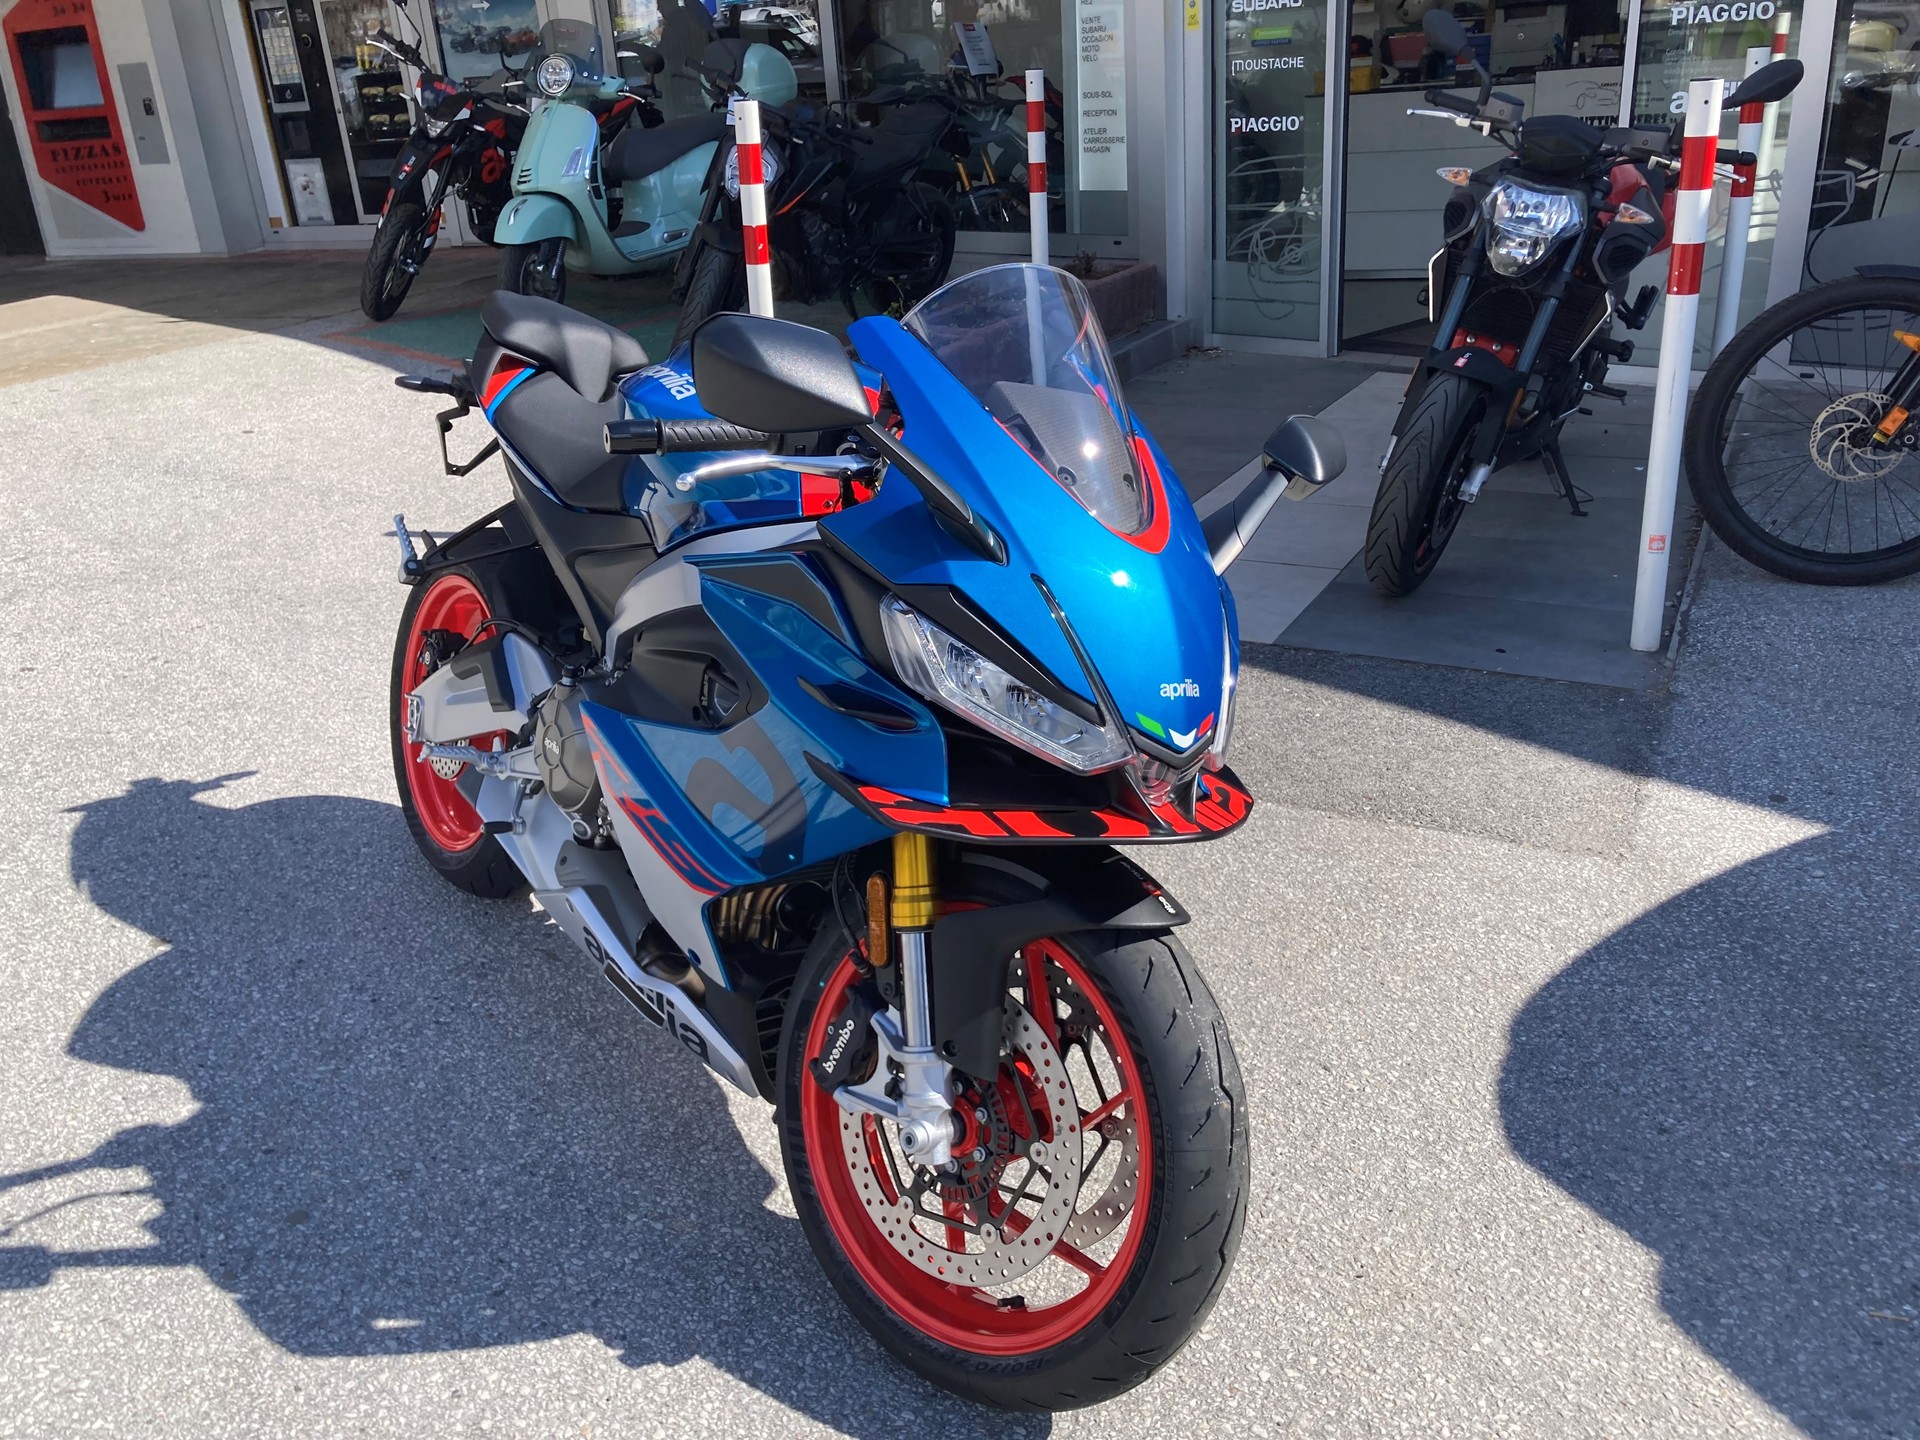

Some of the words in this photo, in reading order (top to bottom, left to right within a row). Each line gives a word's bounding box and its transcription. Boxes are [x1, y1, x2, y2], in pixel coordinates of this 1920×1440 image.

[1671, 2, 1775, 25] PIAGGIO
[1081, 16, 1101, 24] VENTE
[1082, 26, 1106, 34] SUBARU
[1082, 35, 1113, 43] OCCASION
[1083, 91, 1112, 99] SOUS-SOL
[1230, 116, 1300, 132] PIAGGIO
[1083, 136, 1126, 144] CARROSSERIE
[51, 143, 121, 163] PIZZAS
[1160, 679, 1200, 700] aprilia
[822, 1020, 855, 1073] brembo
